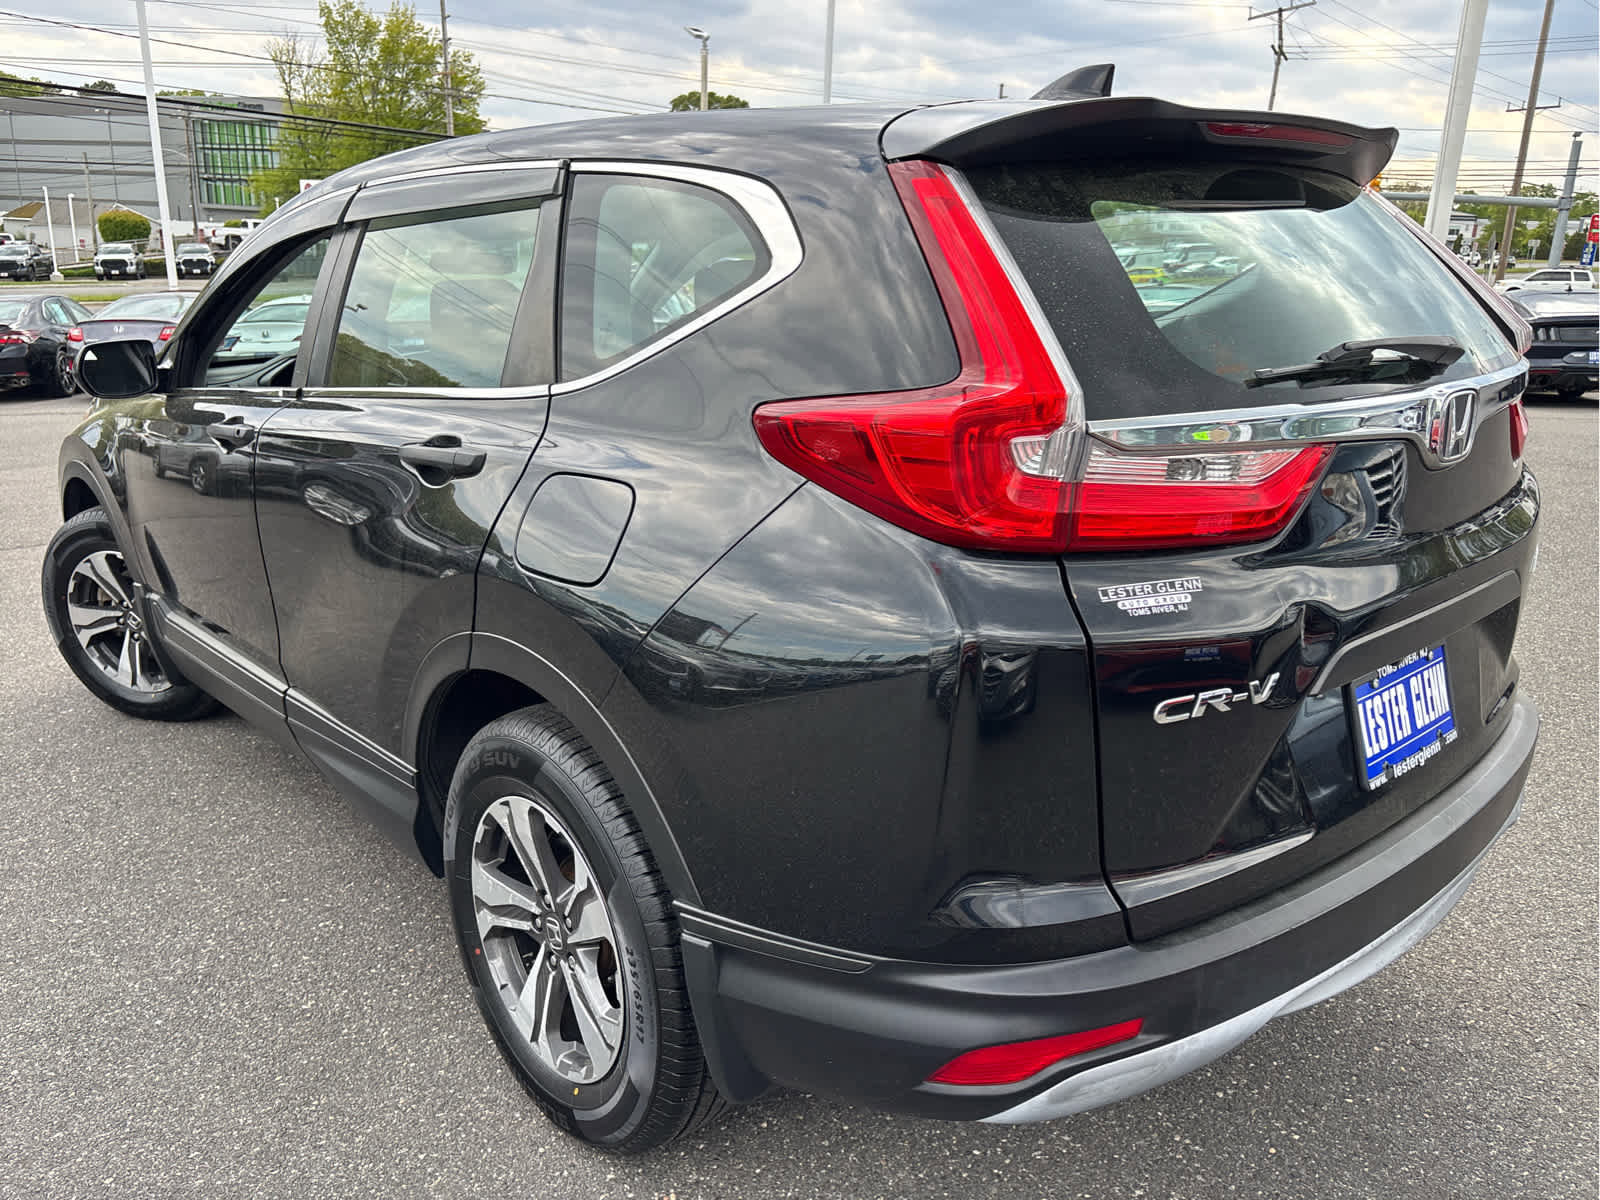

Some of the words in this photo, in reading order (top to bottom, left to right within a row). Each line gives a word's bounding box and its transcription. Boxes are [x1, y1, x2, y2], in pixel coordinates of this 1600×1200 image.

[1099, 584, 1153, 600] LESTER
[1157, 580, 1202, 593] GLENN
[1121, 599, 1149, 608] AUTO
[1154, 595, 1188, 604] GROUP
[1127, 607, 1151, 616] TOMS
[1178, 603, 1188, 611] NJ
[1419, 646, 1428, 658] NJ
[1153, 671, 1280, 724] CR-V
[1358, 683, 1412, 759] LESTER
[1410, 661, 1450, 729] GLENN
[484, 751, 520, 769] SUV
